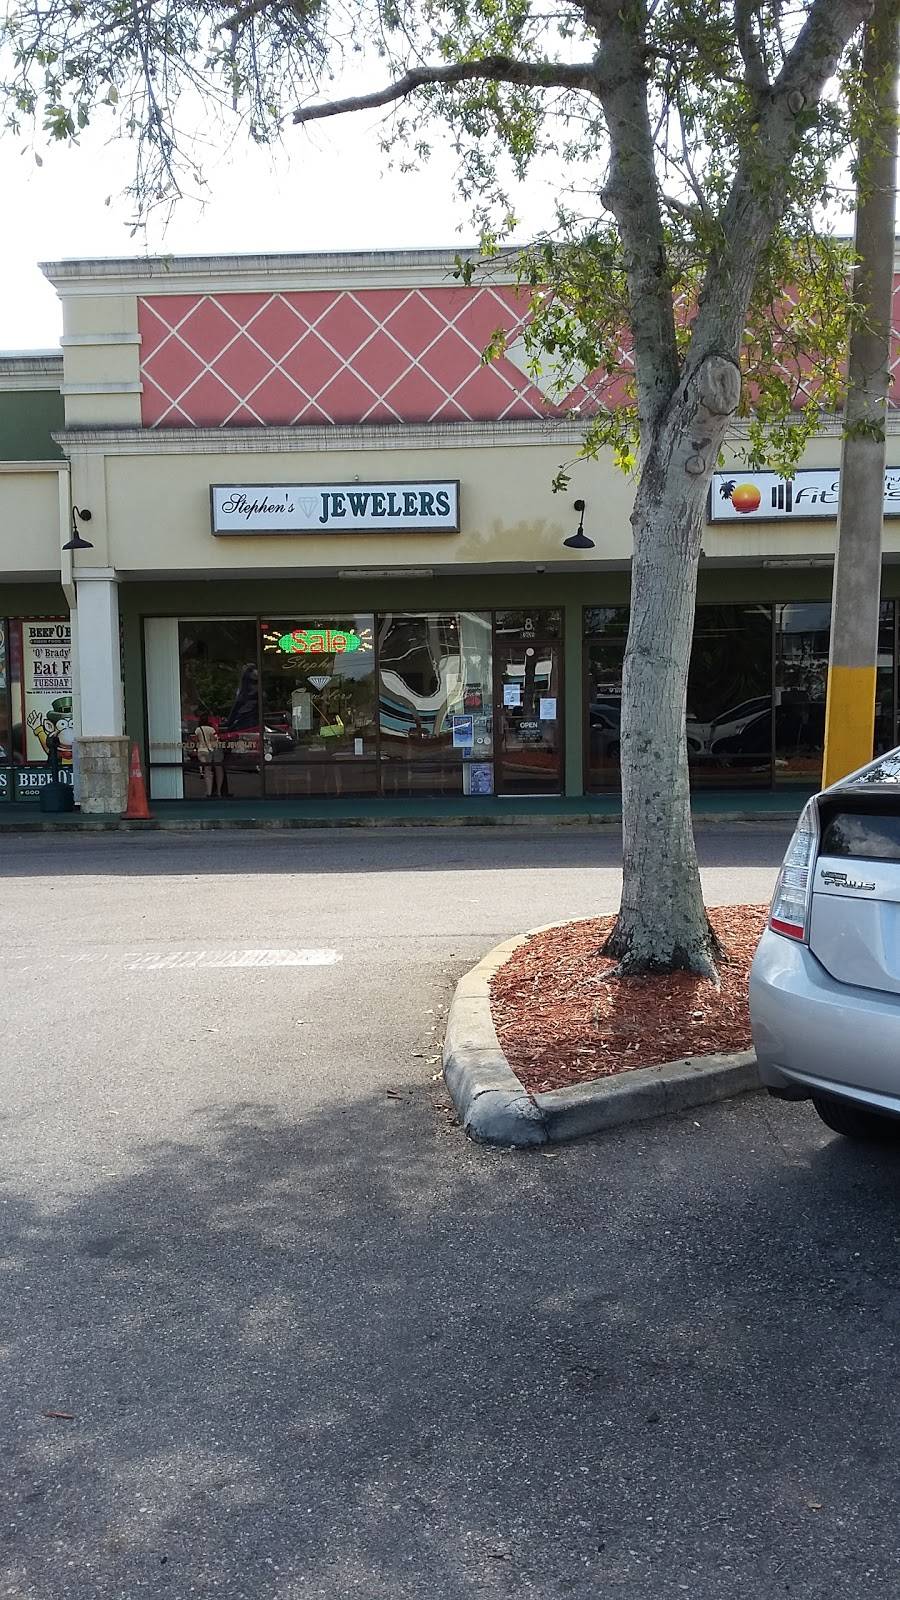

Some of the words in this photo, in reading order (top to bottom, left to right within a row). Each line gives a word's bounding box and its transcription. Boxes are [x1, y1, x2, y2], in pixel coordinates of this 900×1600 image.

[222, 493, 295, 520] Stephen's
[319, 491, 451, 523] JEWELERS
[291, 629, 347, 654] Sale
[33, 661, 58, 675] Eat
[62, 660, 71, 675] F
[34, 679, 69, 687] TUESDAY
[824, 878, 876, 891] PRIUS
